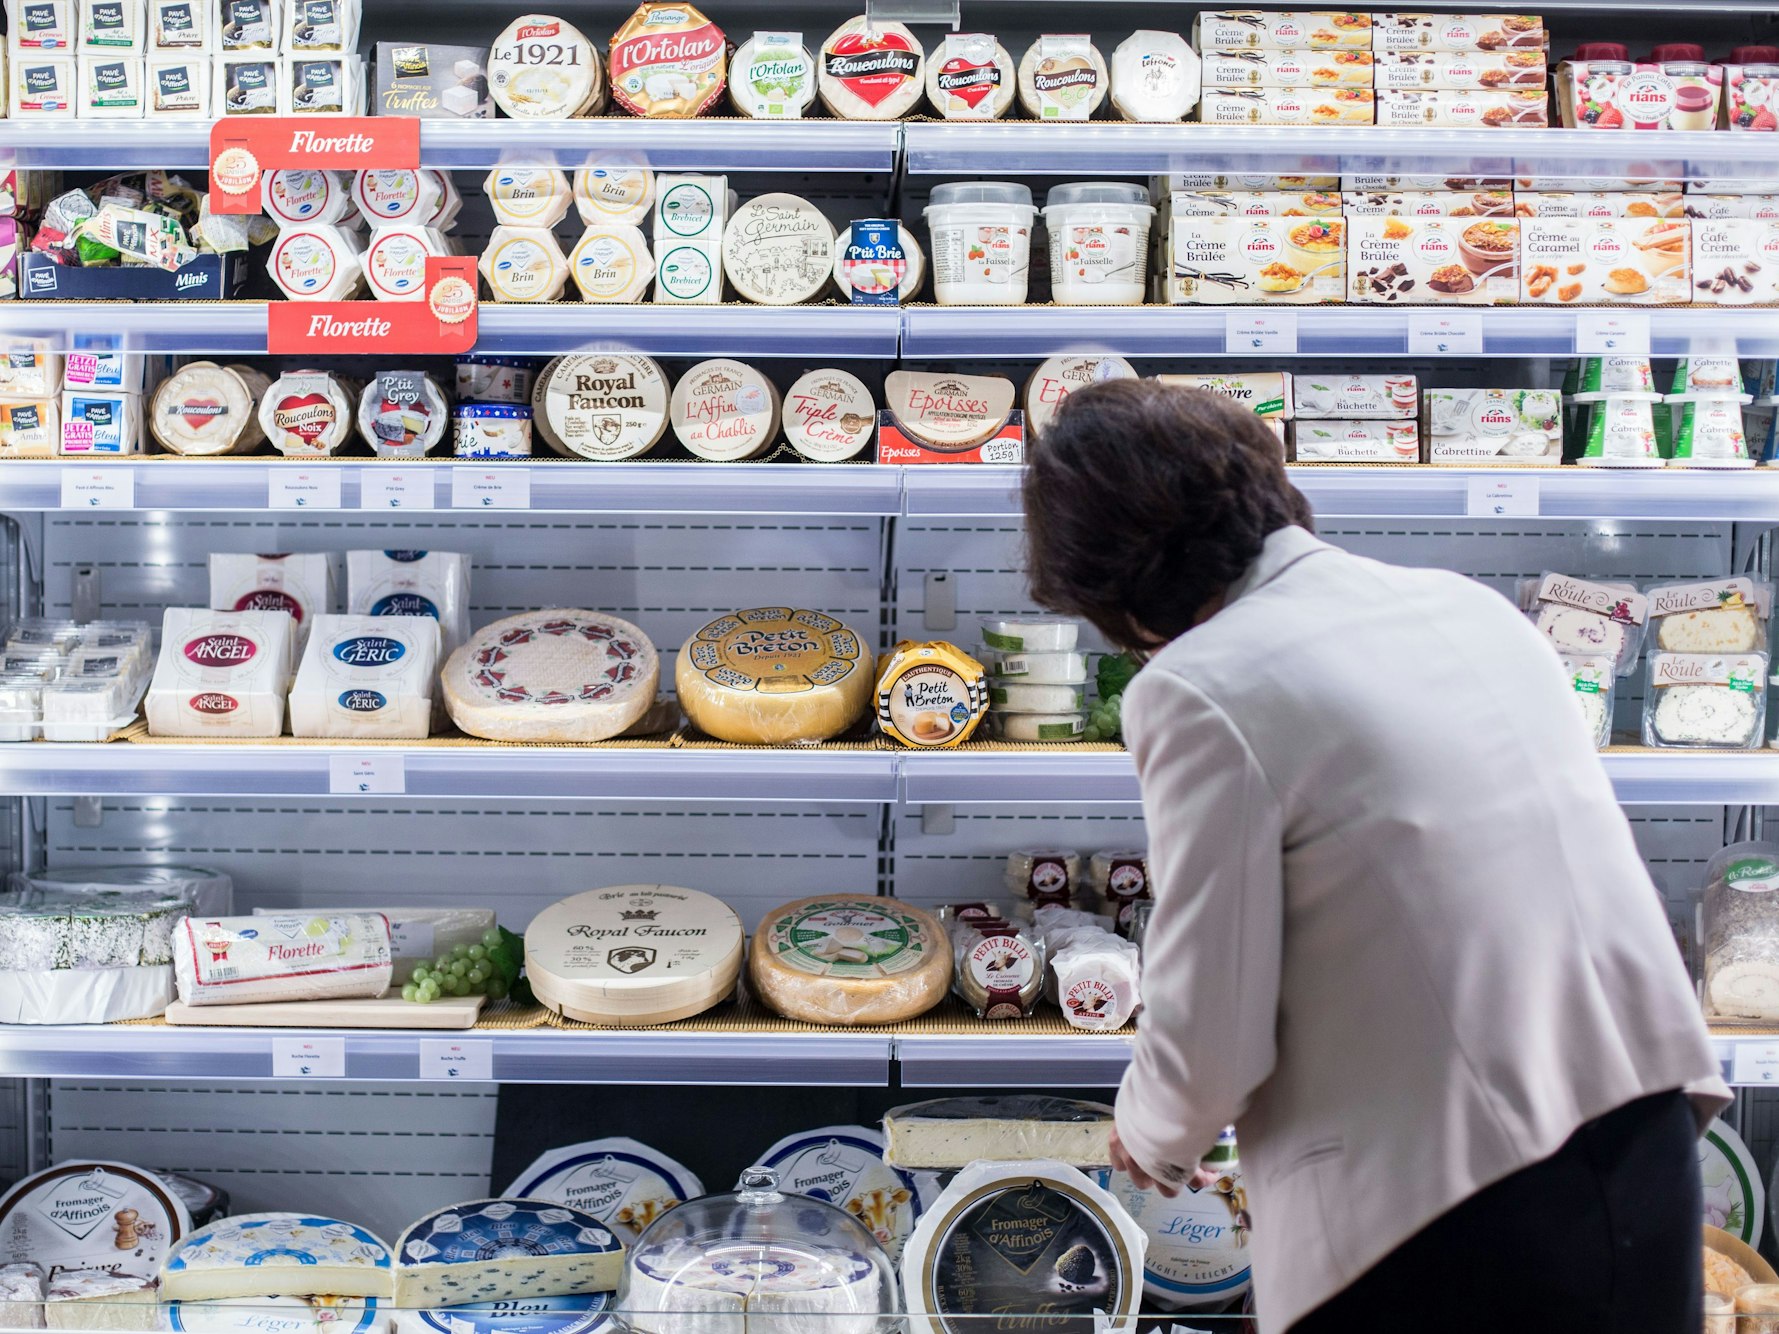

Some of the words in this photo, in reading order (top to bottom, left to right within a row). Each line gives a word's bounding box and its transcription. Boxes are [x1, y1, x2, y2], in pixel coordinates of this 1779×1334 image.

[32, 8, 49, 17] PAVÉ
[99, 7, 116, 16] PAVÉ
[168, 9, 185, 17] PAVÉ
[27, 15, 55, 25] d'Affinois
[521, 27, 556, 38] l'Ortolan
[1215, 37, 1243, 45] Brûlée
[494, 48, 511, 60] Le
[513, 43, 581, 66] 1921
[622, 36, 714, 68] l'Ortolan
[680, 53, 722, 72] L'original
[831, 52, 914, 74] Roucoulons
[32, 71, 50, 80] PAVÉ
[750, 63, 804, 80] l'Ortolan
[939, 69, 999, 89] Roucoulons
[1036, 71, 1096, 90] Roucoulons
[383, 90, 439, 110] Truffes
[1629, 92, 1667, 102] rians
[289, 131, 374, 153] Florette
[225, 156, 246, 170] 25
[220, 175, 252, 185] JUBILÄUM
[1183, 179, 1212, 188] Brûlée
[512, 189, 535, 199] Brin
[602, 184, 627, 197] Brin
[750, 204, 766, 218] Le
[766, 206, 801, 222] Saint
[1186, 208, 1215, 216] Crème
[1246, 208, 1270, 216] rians
[1416, 207, 1441, 216] rians
[1709, 206, 1730, 215] Café
[671, 213, 703, 222] Brebicet
[744, 218, 820, 245] Germain
[1528, 232, 1568, 242] Crème
[1701, 232, 1728, 242] Café
[150, 227, 160, 258] MIX
[1187, 240, 1227, 251] Crème
[1247, 242, 1275, 251] rians
[1360, 239, 1400, 250] Crème
[1420, 243, 1448, 251] rians
[1528, 243, 1580, 253] Caramel
[1593, 242, 1621, 251] rians
[1701, 242, 1741, 252] Crème
[850, 245, 876, 260] P'tit
[876, 244, 902, 260] Brie
[1187, 251, 1226, 262] Brûlée
[1360, 250, 1400, 262] Brûlée
[290, 267, 324, 279] Florette
[383, 266, 418, 277] Florette
[511, 272, 535, 283] Brin
[594, 269, 617, 280] Brin
[175, 272, 208, 287] Minis
[670, 276, 702, 285] Brebicet
[441, 285, 463, 297] 25
[436, 304, 469, 314] JUBILÄUM
[307, 315, 392, 336] Florette
[68, 354, 97, 364] JETZT
[1608, 359, 1647, 368] Cabrette
[1694, 358, 1733, 367] Cabrette
[67, 363, 96, 372] GRATIS
[96, 363, 120, 374] Bleu
[534, 357, 563, 403] CAMEMBERT
[689, 366, 715, 386] FROMAGES
[723, 367, 744, 378] FRANCE
[382, 376, 414, 391] P'tit
[575, 373, 636, 395] Royal
[692, 381, 743, 398] GERMAIN
[387, 388, 420, 405] Grey
[809, 386, 855, 404] GERMAIN
[934, 389, 968, 397] GERMAIN
[568, 393, 646, 411] Faucon
[908, 388, 989, 419] Epoisses
[1336, 401, 1378, 411] Buchette
[176, 405, 223, 415] Roucoulons
[276, 405, 334, 426] Roucoulons
[793, 394, 838, 426] Triple
[1480, 414, 1512, 424] rians
[64, 423, 93, 432] JETZT
[299, 422, 322, 433] Noix
[690, 431, 703, 441] au
[706, 418, 757, 441] Chablis
[806, 420, 856, 446] Crème
[1611, 425, 1649, 434] Cabrette
[1700, 426, 1738, 434] Cabrette
[64, 431, 93, 440] GRATIS
[94, 429, 119, 441] Bleu
[454, 428, 478, 449] Brie
[881, 446, 921, 462] Epoisses
[989, 450, 1014, 461] 125g
[1337, 447, 1379, 457] Buchette
[1433, 447, 1492, 457] Cabrettine
[1563, 580, 1577, 590] Le
[254, 594, 284, 608] Saint
[744, 613, 787, 622] Breton
[704, 618, 729, 634] Petit
[713, 620, 739, 639] Breton
[735, 628, 809, 643] Petit
[208, 637, 239, 650] Saint
[357, 639, 388, 651] Saint
[728, 640, 820, 656] Breton
[189, 642, 251, 660] ANGEL
[753, 652, 782, 662] Depuis
[1672, 656, 1685, 665] Le
[902, 666, 953, 682] L'AUTHENTIQUE
[915, 682, 949, 696] Petit
[203, 693, 228, 702] Saint
[913, 692, 955, 706] Breton
[193, 698, 235, 710] ANGEL
[823, 921, 875, 929] Gourmet
[566, 924, 630, 941] Royal
[634, 924, 708, 938] Faucon
[267, 942, 325, 962] Florette
[973, 937, 1000, 962] PETIT
[1001, 938, 1030, 961] BILLY
[1068, 980, 1092, 998] PETIT
[1092, 980, 1116, 1001] BILLY
[794, 1170, 845, 1189] Fromager
[566, 1181, 618, 1198] Fromager
[55, 1196, 104, 1210] Fromager
[564, 1189, 623, 1210] d'Affinois
[50, 1202, 111, 1220] d'Affinois
[490, 1221, 517, 1230] Bleu
[991, 1216, 1049, 1231] Fromager
[12, 1228, 28, 1236] 2kg
[460, 1228, 482, 1242] Bleu
[1158, 1216, 1227, 1244] Léger
[988, 1228, 1054, 1249] d'Affinois
[955, 1254, 972, 1264] 2kg
[955, 1263, 973, 1272] 30%
[1146, 1258, 1177, 1277] LIGHT
[1195, 1264, 1235, 1280] LEICHT
[958, 1288, 976, 1298] 60%
[488, 1300, 551, 1319] Bleu
[233, 1313, 307, 1333] Léger
[991, 1302, 1073, 1332] Truffes
